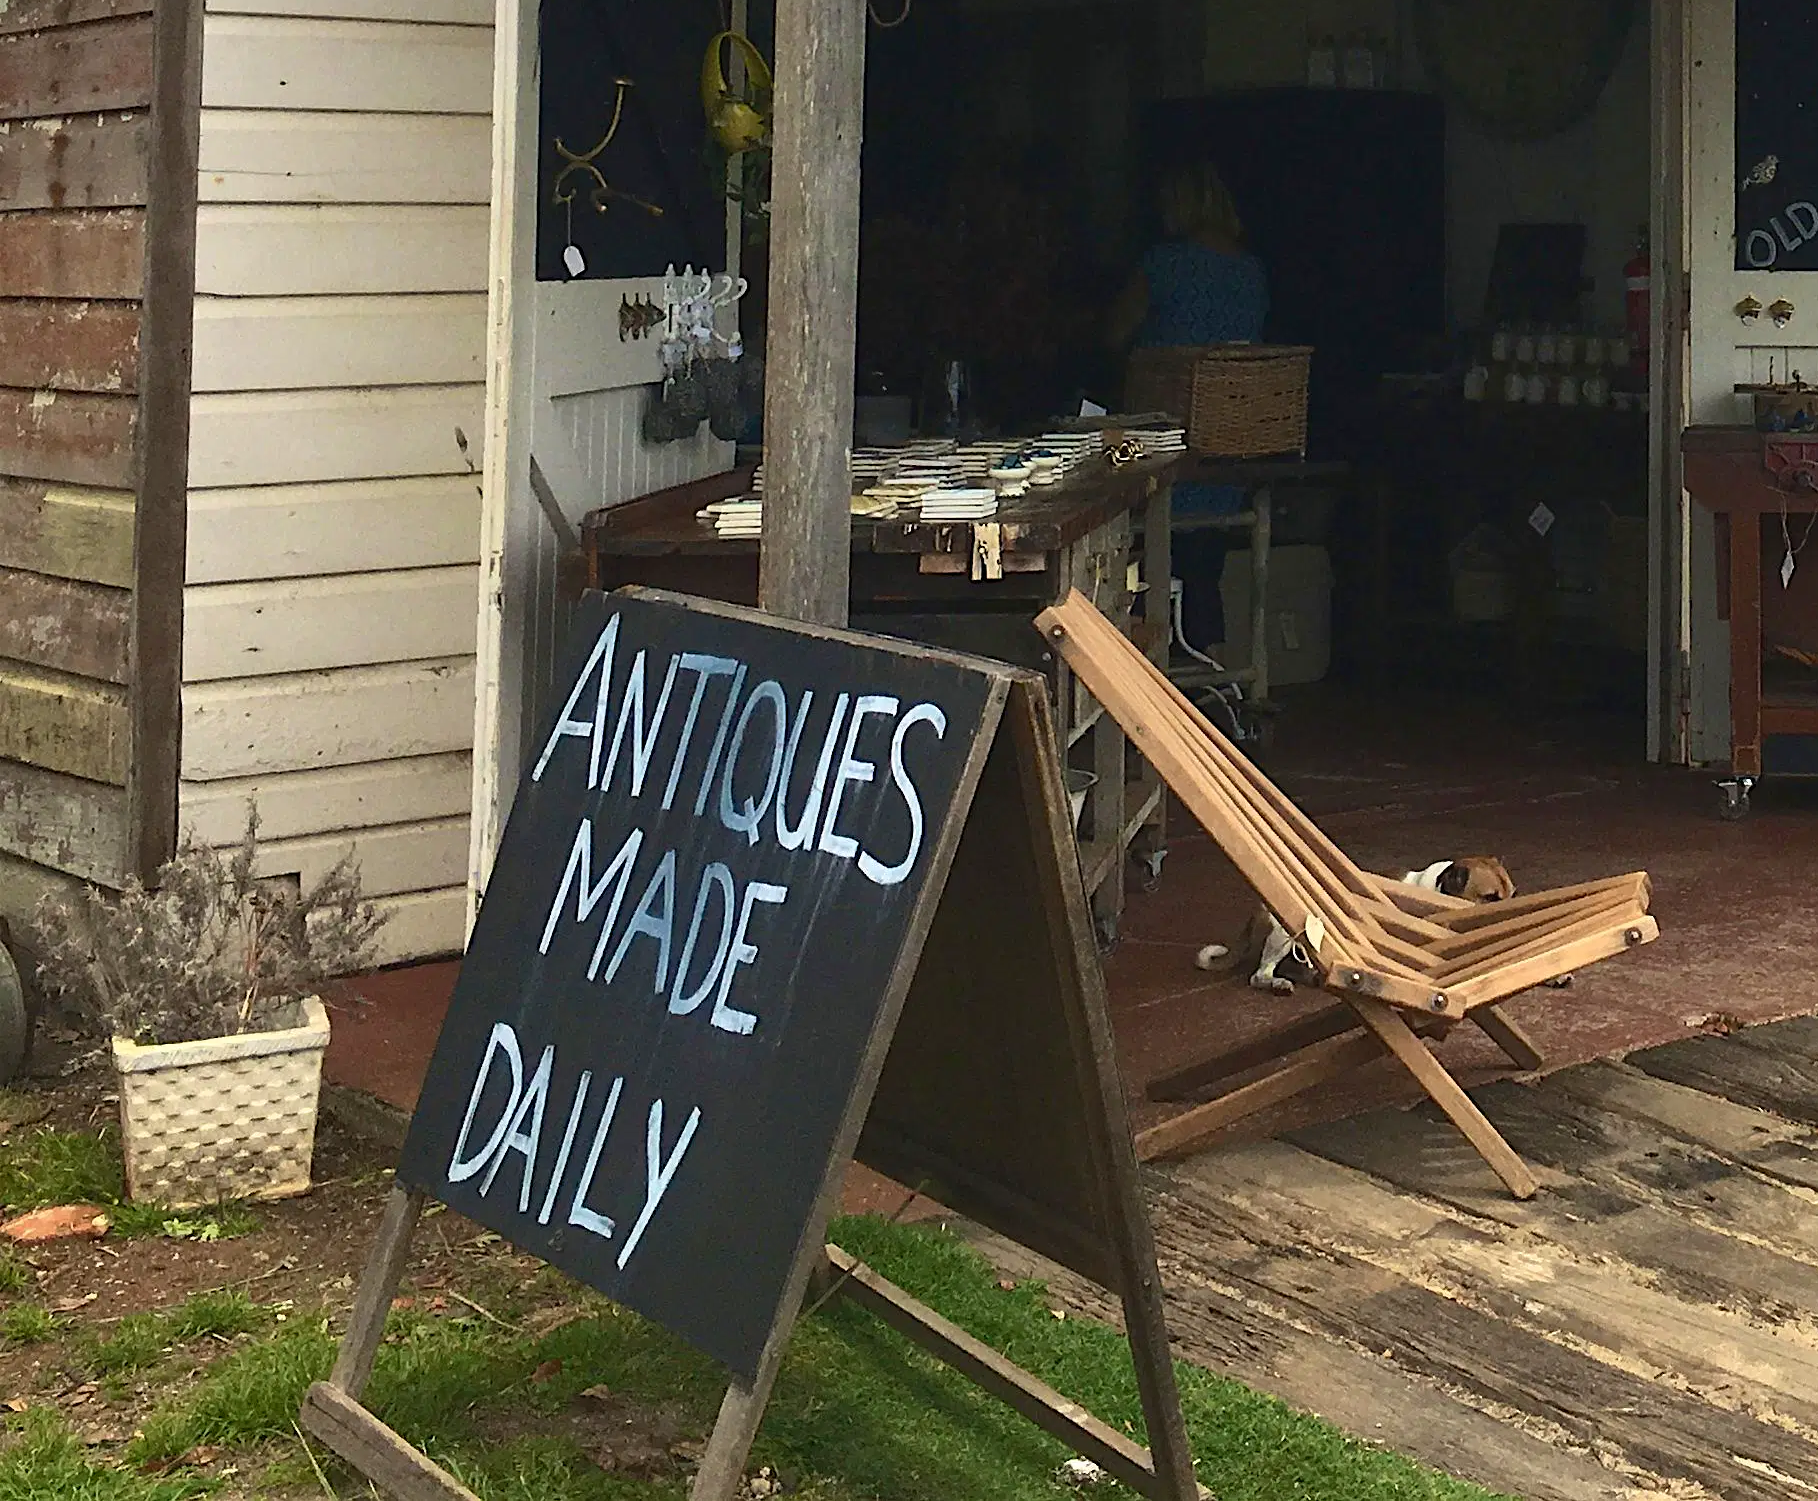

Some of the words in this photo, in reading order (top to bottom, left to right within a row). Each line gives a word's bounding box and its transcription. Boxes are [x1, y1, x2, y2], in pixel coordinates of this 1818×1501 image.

[532, 611, 948, 886] ANTIQUES
[538, 817, 788, 1036] MADE
[447, 1022, 702, 1272] DAILY
